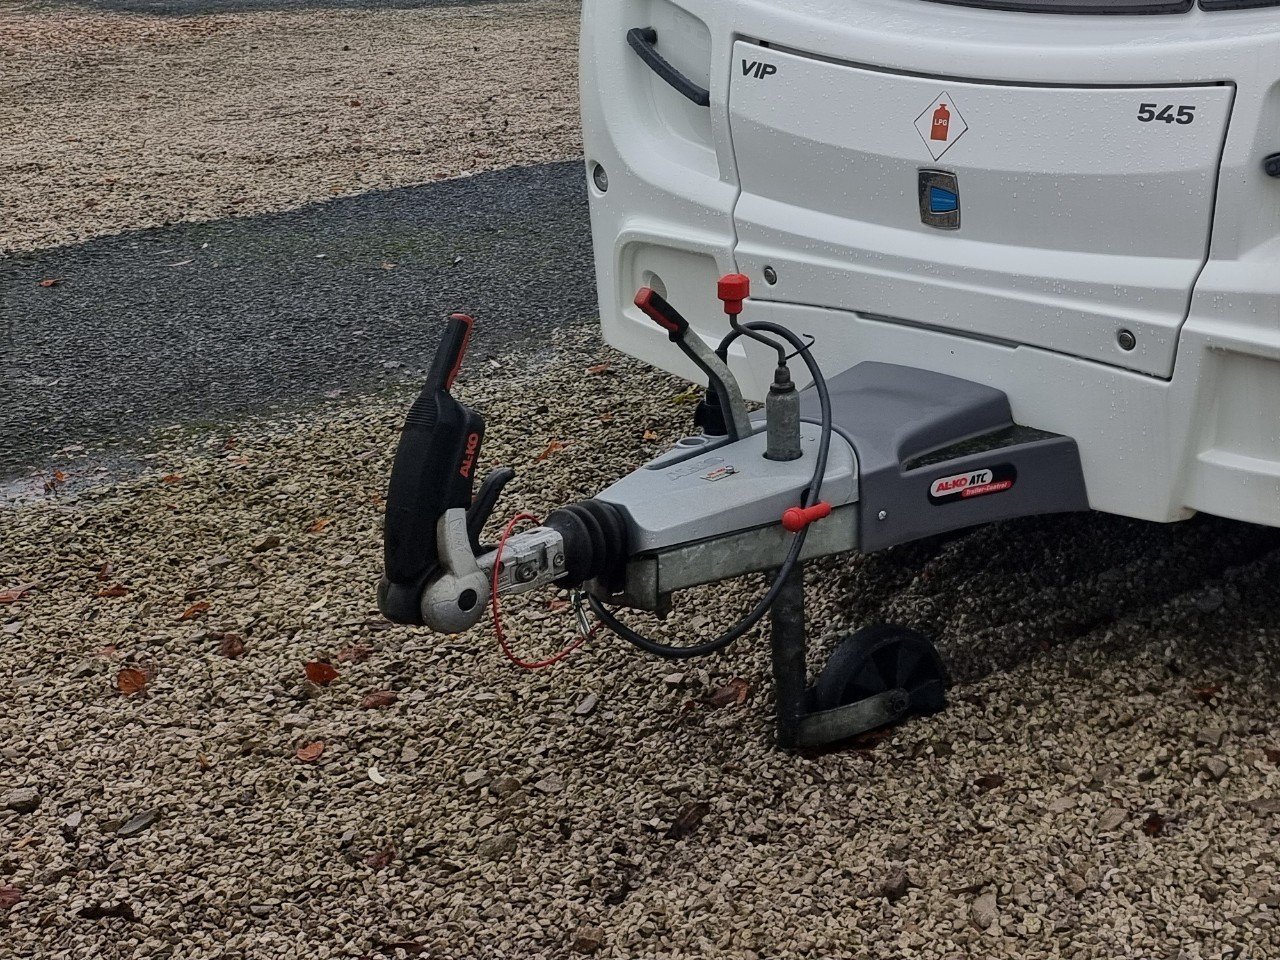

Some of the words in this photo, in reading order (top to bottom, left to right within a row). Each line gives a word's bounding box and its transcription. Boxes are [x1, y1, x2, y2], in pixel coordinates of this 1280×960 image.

[741, 59, 778, 80] VIP
[934, 118, 948, 126] LPG
[1136, 102, 1196, 125] 545
[459, 432, 479, 478] AL-KO
[935, 477, 968, 493] AL-KO
[969, 472, 988, 486] ATC
